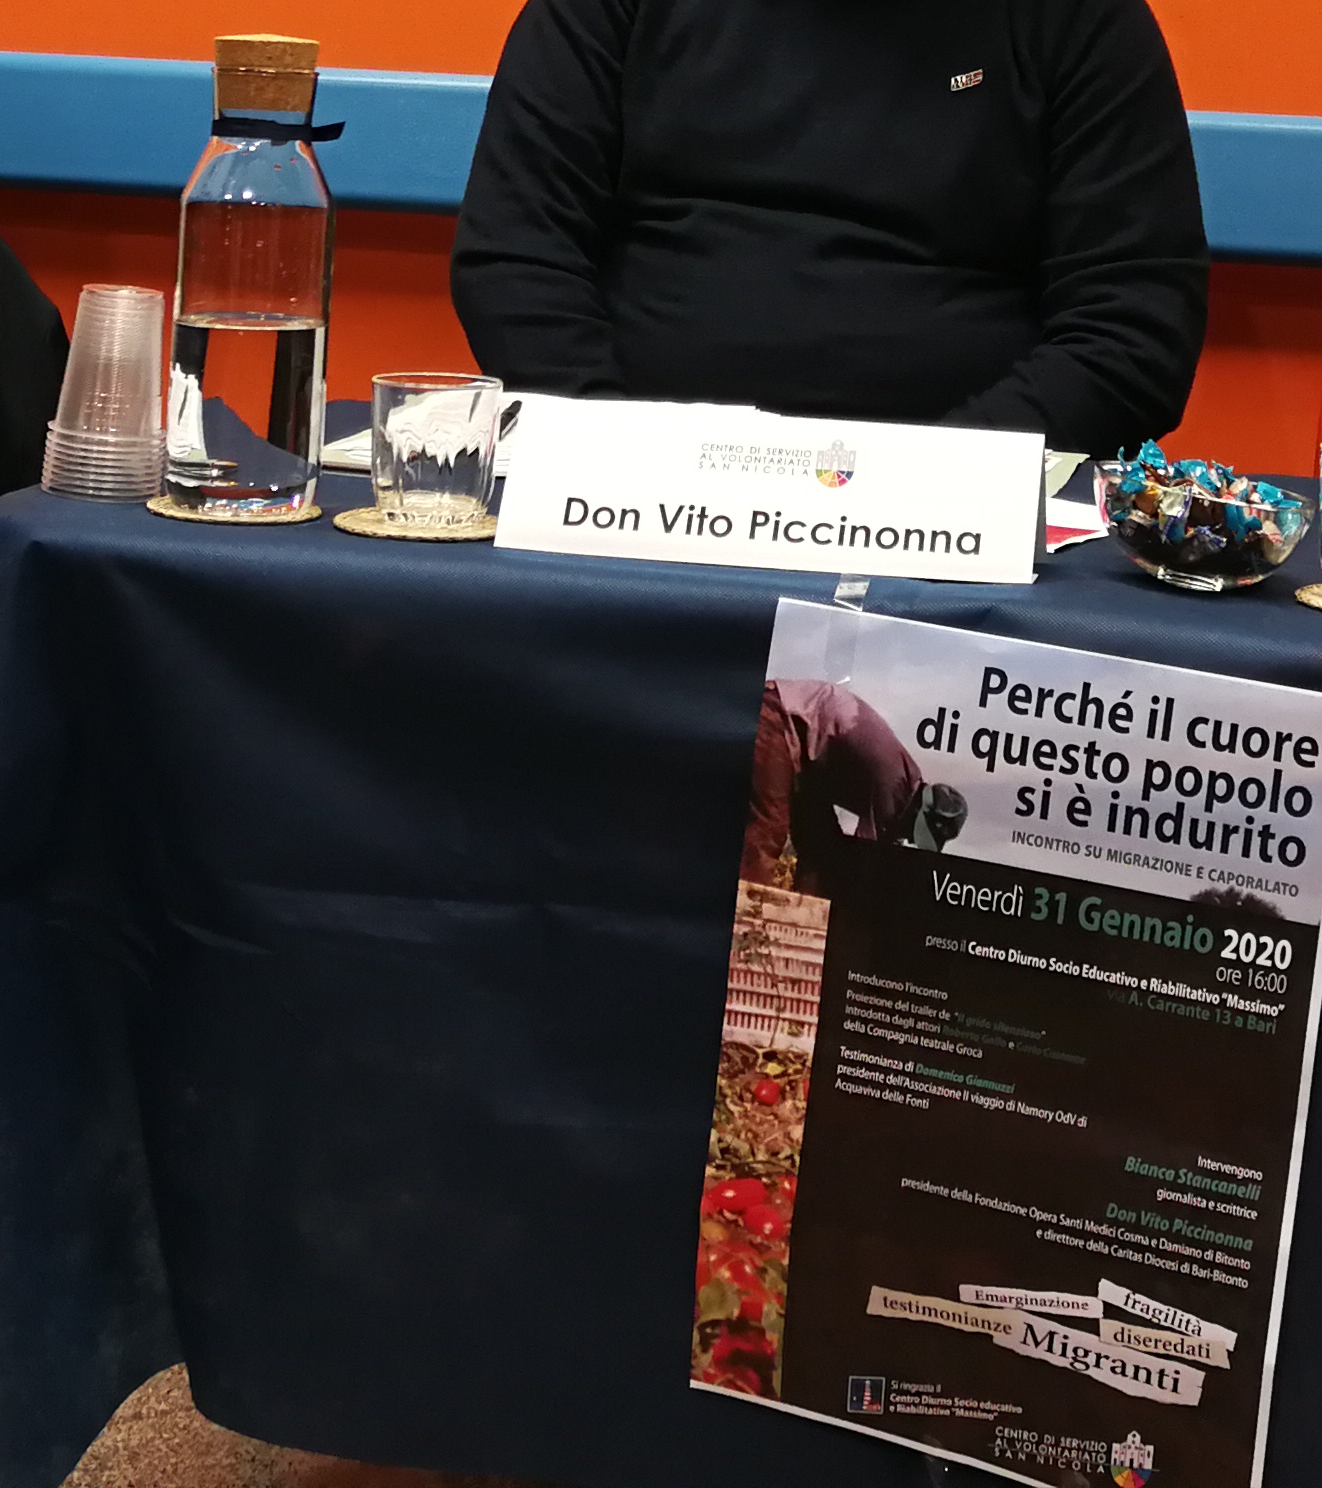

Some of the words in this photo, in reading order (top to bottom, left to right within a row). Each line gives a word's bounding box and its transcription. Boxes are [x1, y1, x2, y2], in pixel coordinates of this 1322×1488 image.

[698, 461, 731, 471] SAN
[741, 464, 809, 477] NICOLA
[700, 453, 713, 461] AL
[721, 454, 811, 468] VOLONTARIATO
[701, 443, 744, 454] CENTRO
[750, 446, 761, 455] DI
[766, 447, 812, 458] SERVIZIO
[562, 497, 641, 532] Don
[658, 502, 733, 538] Vito
[748, 510, 983, 556] Piccinonna
[978, 666, 1133, 734] Perché
[1146, 695, 1175, 742] il
[1186, 716, 1319, 769] cuore
[916, 707, 961, 753] di
[971, 724, 1130, 784] questo
[1141, 758, 1313, 818] popolo
[1014, 778, 1053, 820] si
[1066, 783, 1092, 828] è
[1106, 790, 1307, 868] indurito
[1011, 830, 1081, 857] INCONTRO
[1084, 844, 1102, 860] SU
[1106, 847, 1192, 877] MIGRAZIONE
[1196, 865, 1205, 880] E
[1207, 868, 1300, 898] CAPORALATO
[932, 870, 1024, 917] Venerdì
[1030, 887, 1068, 925] 31
[1078, 896, 1214, 954] Gennaio
[1220, 928, 1292, 969] 2020
[847, 970, 905, 992] Introducono
[925, 933, 958, 952] presso
[959, 939, 967, 953] il
[967, 940, 1006, 962] Centro
[1007, 948, 1047, 971] Diurno
[1048, 957, 1081, 976] Socio
[1082, 963, 1139, 989] Educativo
[1140, 978, 1148, 990] e
[1149, 978, 1221, 1005] Riabilitativo
[1215, 966, 1242, 986] ore
[1247, 968, 1288, 994] 16:00
[846, 989, 893, 1010] Proiezione
[894, 998, 910, 1012] del
[910, 1002, 937, 1018] trailer
[1128, 990, 1144, 1007] A.
[1147, 994, 1211, 1021] Carrante
[1214, 1007, 1231, 1025] 13
[1234, 1016, 1243, 1028] a
[1247, 1015, 1277, 1035] Bari
[843, 1019, 866, 1034] della
[866, 1023, 919, 1046] Compagnia
[919, 1034, 955, 1053] teatrale
[891, 1014, 915, 1030] dagli
[915, 1018, 941, 1034] attori
[1007, 1040, 1015, 1051] e
[839, 1045, 904, 1072] Testimonianza
[904, 1060, 915, 1073] di
[915, 1062, 965, 1084] Domenico
[965, 1073, 1016, 1094] Giannuzzi
[835, 1077, 881, 1100] Acquaviva
[881, 1087, 904, 1105] delle
[905, 1092, 930, 1110] Fonti
[836, 1062, 885, 1084] presidente
[970, 1092, 1005, 1112] viaggio
[1005, 1099, 1016, 1112] di
[1016, 1101, 1055, 1123] Namory
[1055, 1110, 1077, 1126] OdV
[1077, 1115, 1088, 1129] di
[1124, 1155, 1175, 1181] Bianca
[1177, 1168, 1263, 1202] Stancanelli
[1197, 1155, 1263, 1181] Intervengono
[900, 1176, 950, 1198] presidente
[950, 1187, 973, 1204] della
[974, 1192, 1028, 1217] Fondazione
[1028, 1205, 1058, 1225] Opera
[1059, 1213, 1083, 1230] Santi
[1084, 1219, 1117, 1239] Medici
[1150, 1238, 1158, 1249] e
[1158, 1237, 1203, 1260] Damiano
[1203, 1248, 1215, 1262] di
[1215, 1250, 1252, 1272] Bitonto
[1156, 1187, 1207, 1209] giornalista
[1208, 1200, 1215, 1211] e
[1215, 1202, 1258, 1221] scrittrice
[1105, 1202, 1137, 1224] Don
[1140, 1209, 1170, 1232] Vito
[1172, 1218, 1254, 1253] Piccinonna
[1035, 1227, 1043, 1239] e
[1043, 1227, 1085, 1249] direttore
[1085, 1238, 1110, 1256] della
[1110, 1244, 1143, 1263] Caritas
[1144, 1252, 1179, 1272] Diocesi
[1180, 1261, 1190, 1275] di
[1191, 1264, 1249, 1290] Bari-Bitonto
[881, 1293, 1013, 1337] testimonianze
[974, 1289, 1090, 1313] Emarginazione
[1122, 1291, 1203, 1338] fragilità
[1019, 1321, 1182, 1396] Migranti
[1112, 1326, 1212, 1360] diseredati
[889, 1392, 920, 1404] Centro
[921, 1394, 953, 1407] Diurno
[993, 1437, 1011, 1449] AL
[1014, 1440, 1107, 1463] VOLONTARIATO
[994, 1425, 1038, 1443] CENTRO
[1043, 1433, 1055, 1445] DI
[1059, 1435, 1108, 1453] SERVIZIO
[994, 1447, 1027, 1461] SAN
[1035, 1454, 1106, 1474] NICOLA
